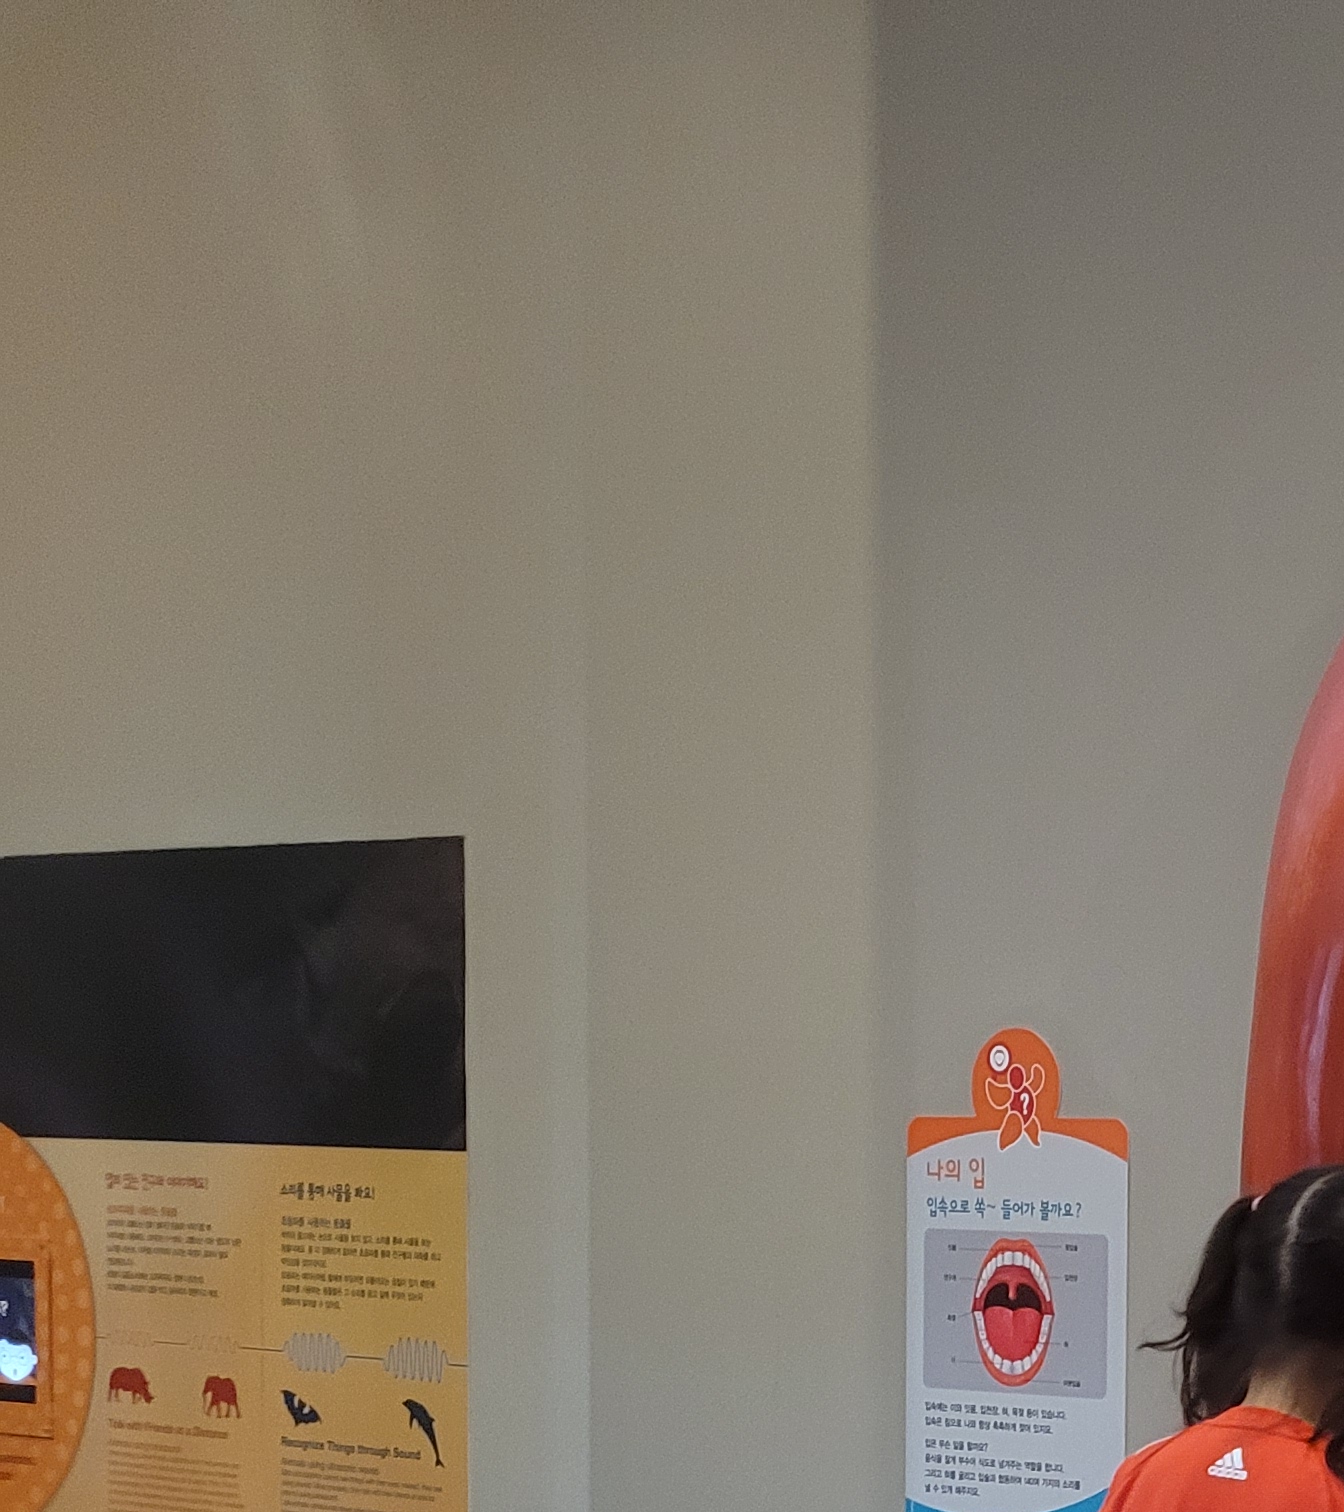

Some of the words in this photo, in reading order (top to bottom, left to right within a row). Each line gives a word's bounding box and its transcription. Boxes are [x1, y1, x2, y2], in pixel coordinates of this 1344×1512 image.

[927, 1159, 961, 1182] 나의
[969, 1157, 985, 1189] 입
[927, 1197, 970, 1217] 입속으로
[1001, 1199, 1035, 1220] 들어가
[1040, 1200, 1081, 1220] 볼까요?
[393, 1447, 421, 1460] Sound
